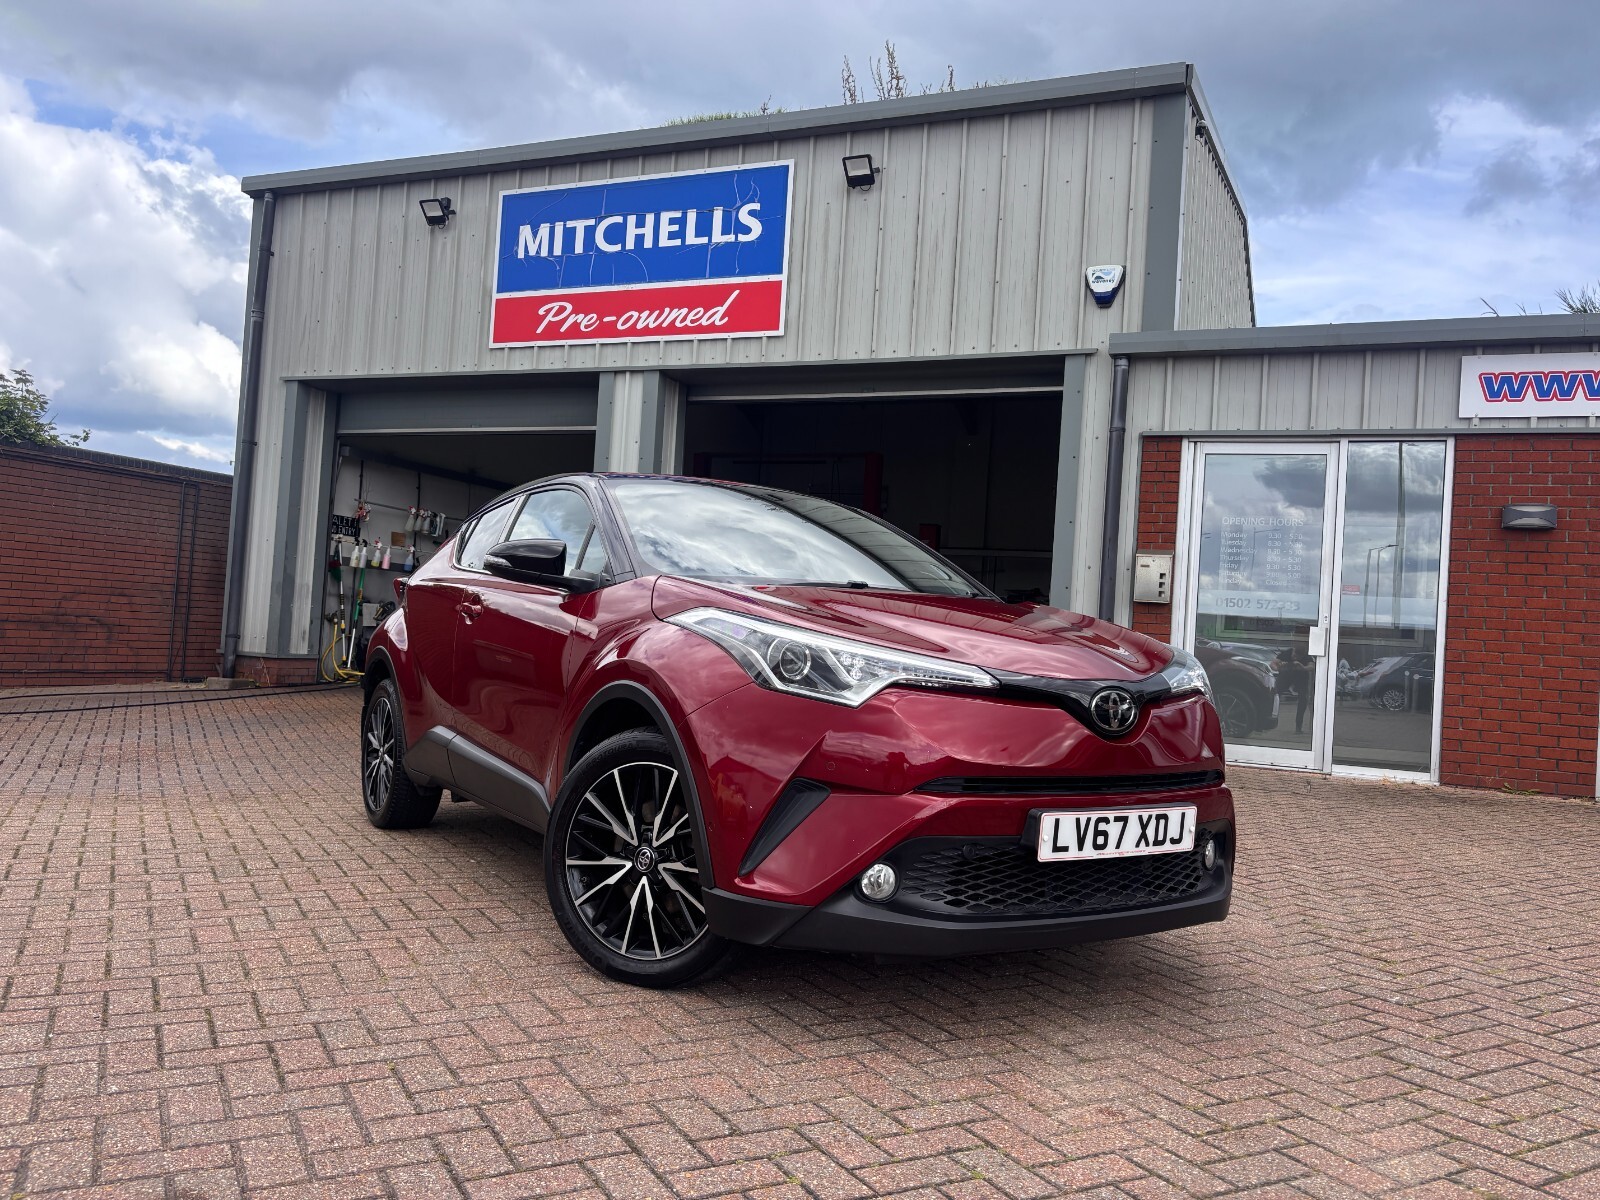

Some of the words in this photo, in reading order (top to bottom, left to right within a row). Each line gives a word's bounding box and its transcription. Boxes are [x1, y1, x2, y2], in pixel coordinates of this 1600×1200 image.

[517, 202, 763, 259] MITCHELLS
[535, 290, 741, 334] Pre-owned
[332, 515, 352, 526] ALET
[1222, 516, 1265, 526] OPENING
[1269, 517, 1304, 527] HOURS
[1221, 531, 1247, 539] Monday
[1220, 546, 1258, 554] Wednesday
[1220, 554, 1249, 562] Thursday
[1215, 597, 1251, 608] 01502
[1052, 815, 1129, 853] LV67
[1135, 812, 1186, 848] XDJ
